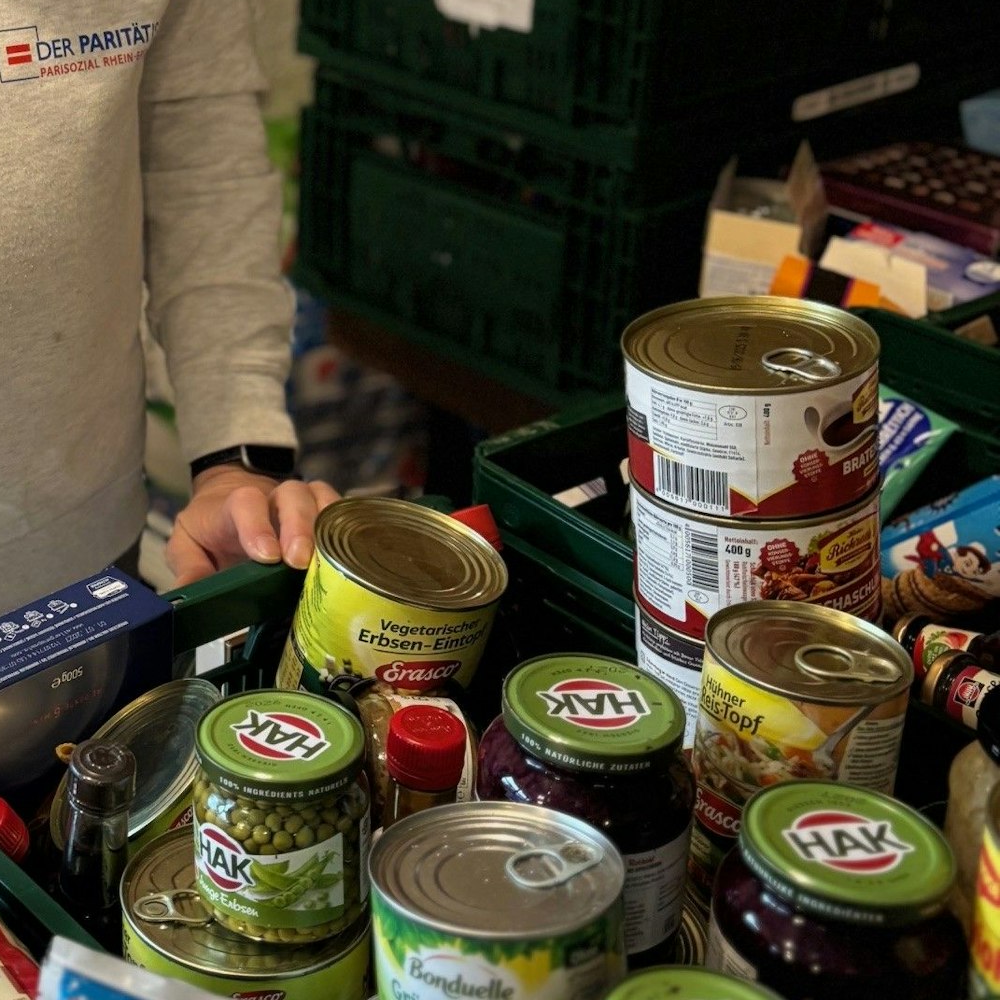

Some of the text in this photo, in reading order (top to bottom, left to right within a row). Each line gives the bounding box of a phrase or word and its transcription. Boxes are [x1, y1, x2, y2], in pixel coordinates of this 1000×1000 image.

[36, 38, 75, 61] DER
[40, 59, 100, 78] PARISOZIAL
[725, 544, 751, 557] 400 g
[358, 623, 488, 650] Erbsen-Eintopf
[380, 618, 481, 637] Vegetarischer
[382, 660, 459, 682] Erasco
[540, 692, 647, 715] HAK
[706, 675, 746, 707] Hühner
[232, 711, 327, 760] HAK
[520, 733, 541, 751] 100%
[545, 748, 604, 770] NATÜRLICHE
[219, 776, 240, 790] 100%
[242, 784, 304, 799] INGRÉDIENTS
[788, 823, 912, 859] HAK
[200, 836, 254, 885] HAK
[409, 957, 514, 999] Bonduelle
